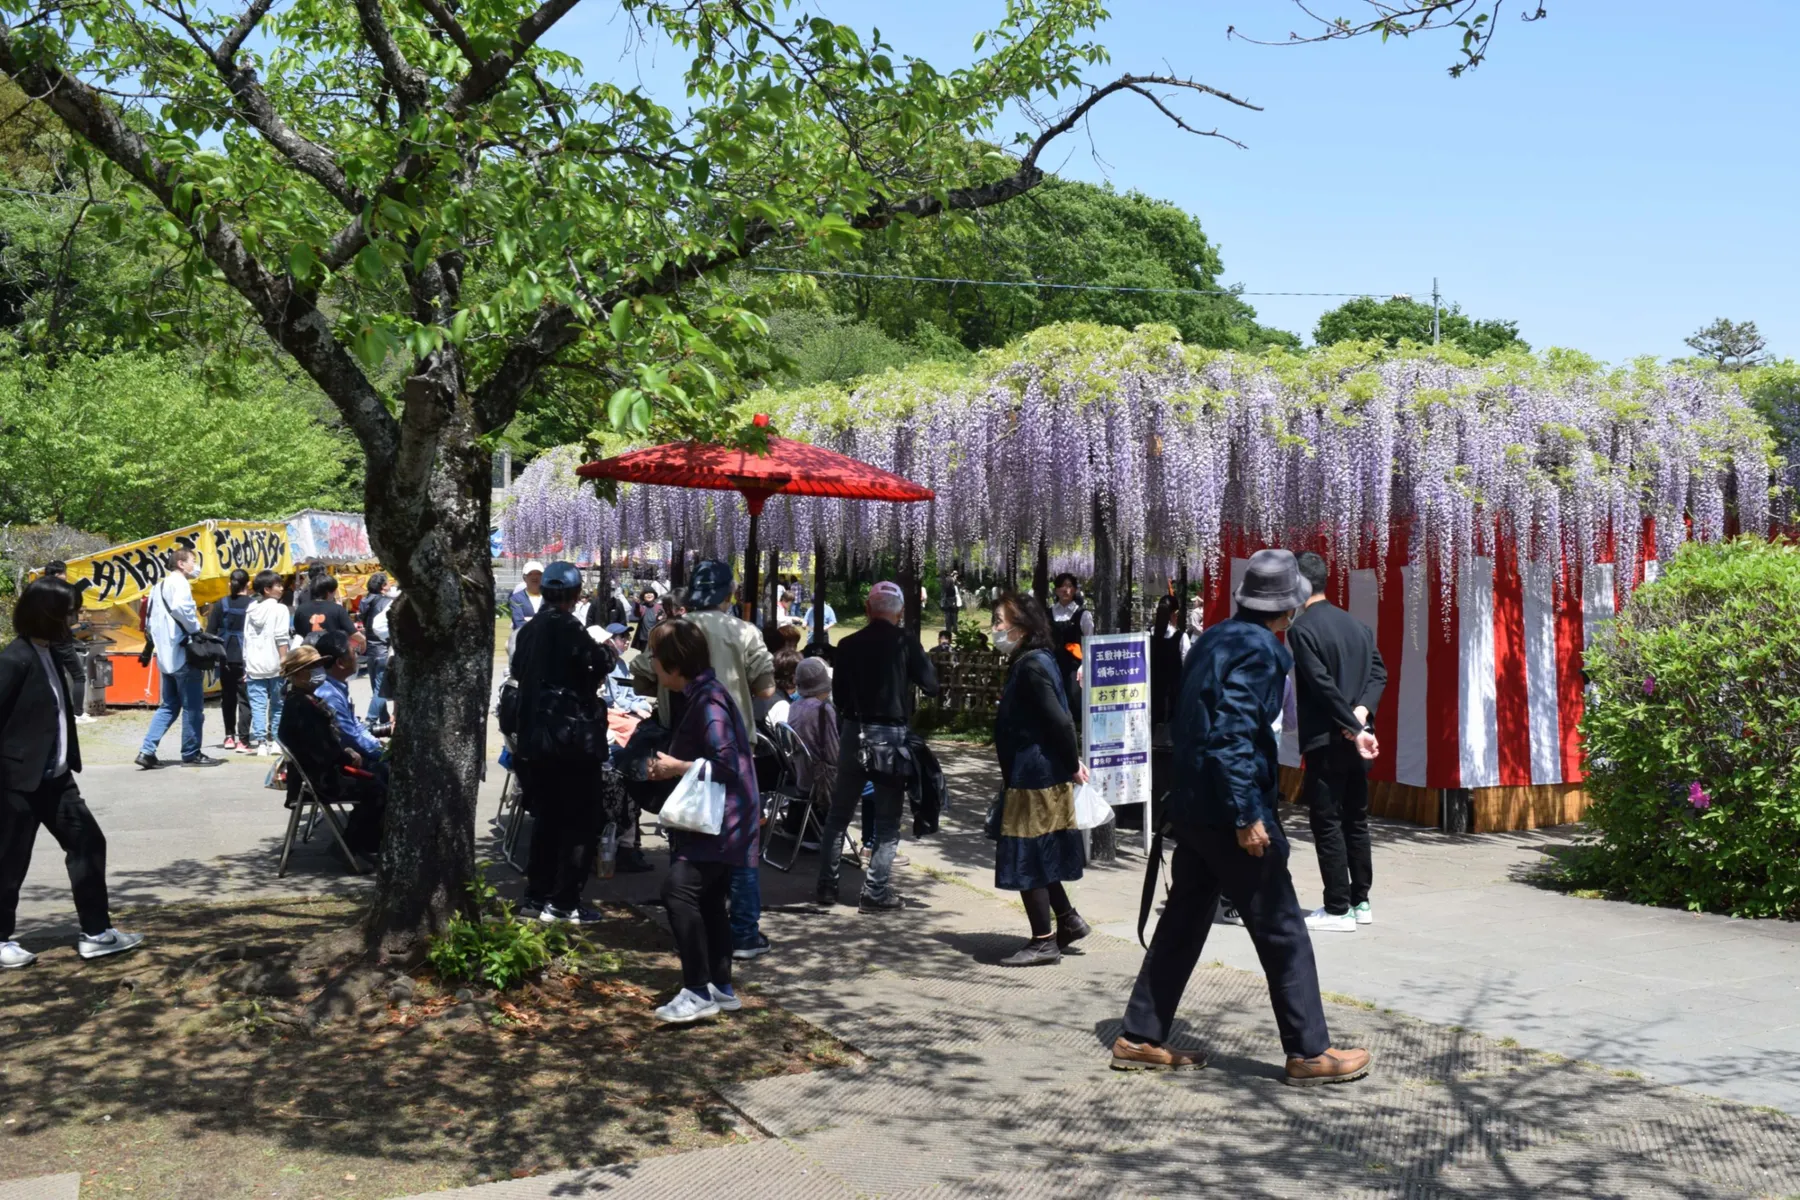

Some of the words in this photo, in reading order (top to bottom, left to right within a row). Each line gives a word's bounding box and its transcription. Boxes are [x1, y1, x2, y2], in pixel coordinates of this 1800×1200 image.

[213, 528, 286, 570] じゃがバター
[1095, 648, 1141, 662] 玉敷神社にて
[1097, 666, 1140, 678] 頒布しています
[1098, 687, 1140, 702] おすすめ
